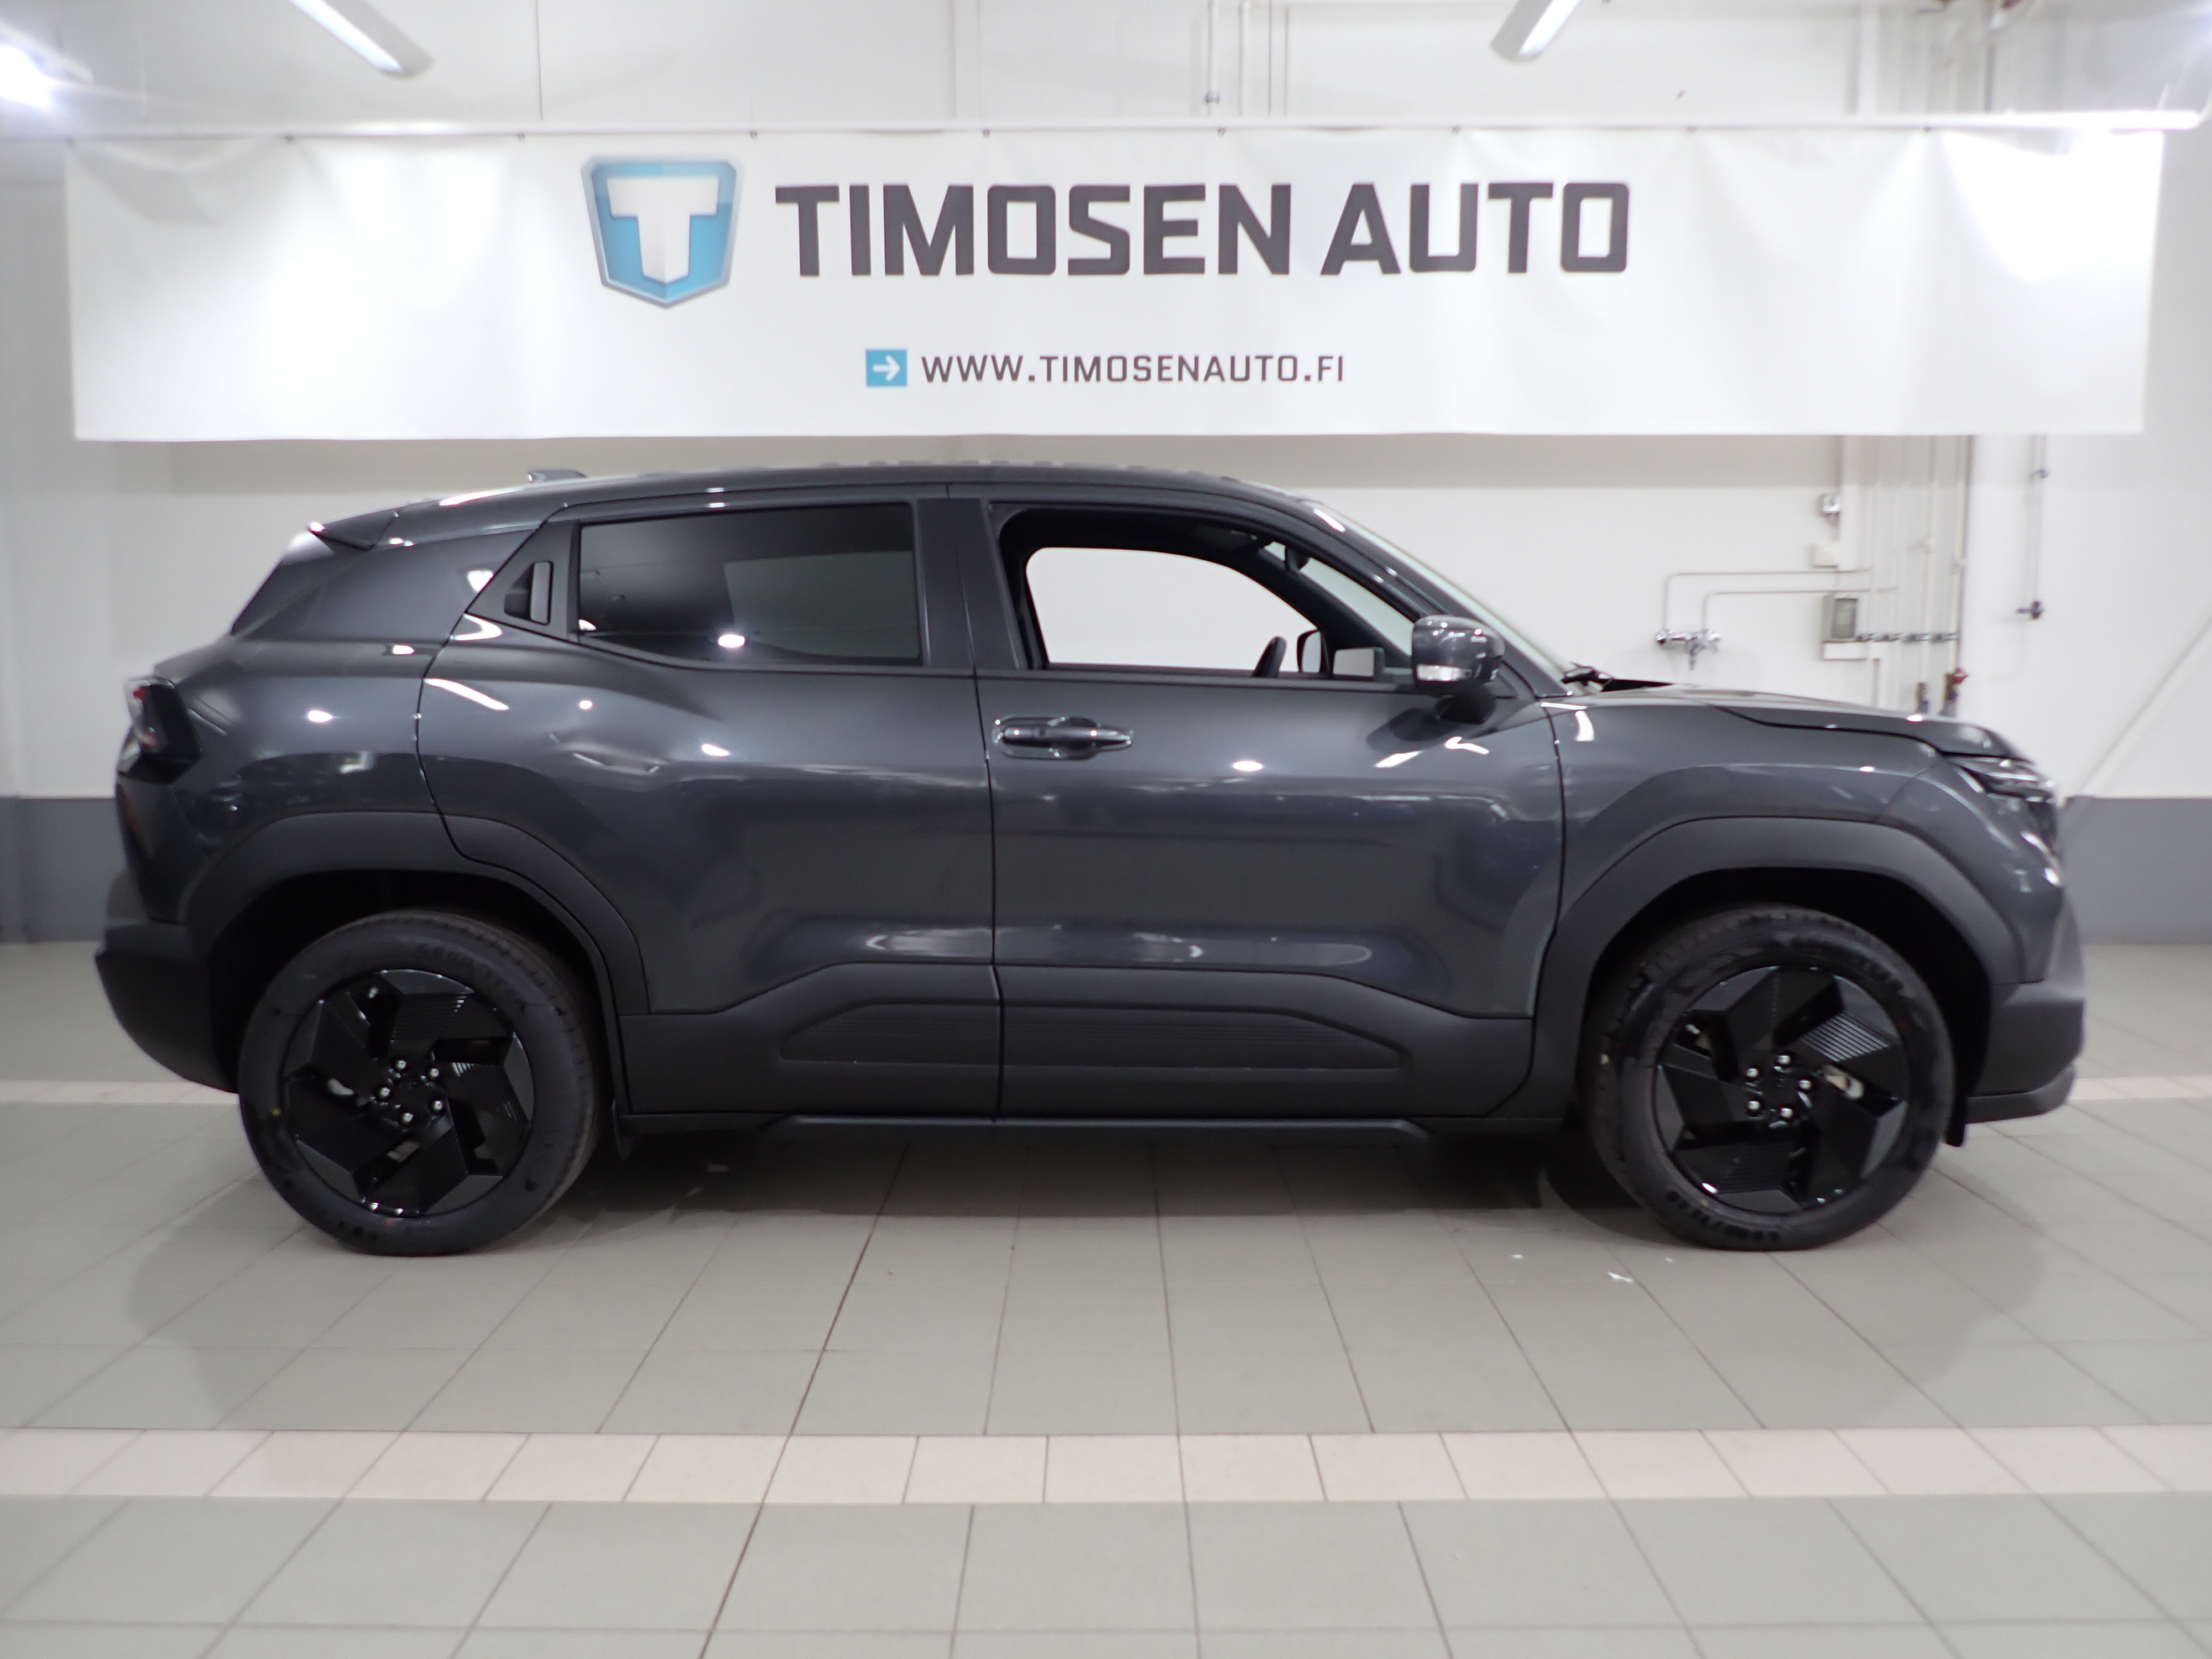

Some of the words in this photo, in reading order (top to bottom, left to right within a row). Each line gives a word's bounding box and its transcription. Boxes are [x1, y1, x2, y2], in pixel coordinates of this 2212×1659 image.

[607, 176, 720, 283] T
[775, 183, 1291, 276] TIMOSEN
[1320, 182, 1629, 275] AUTO
[921, 354, 1343, 383] WWW.TIMOSENAUTO.FI
